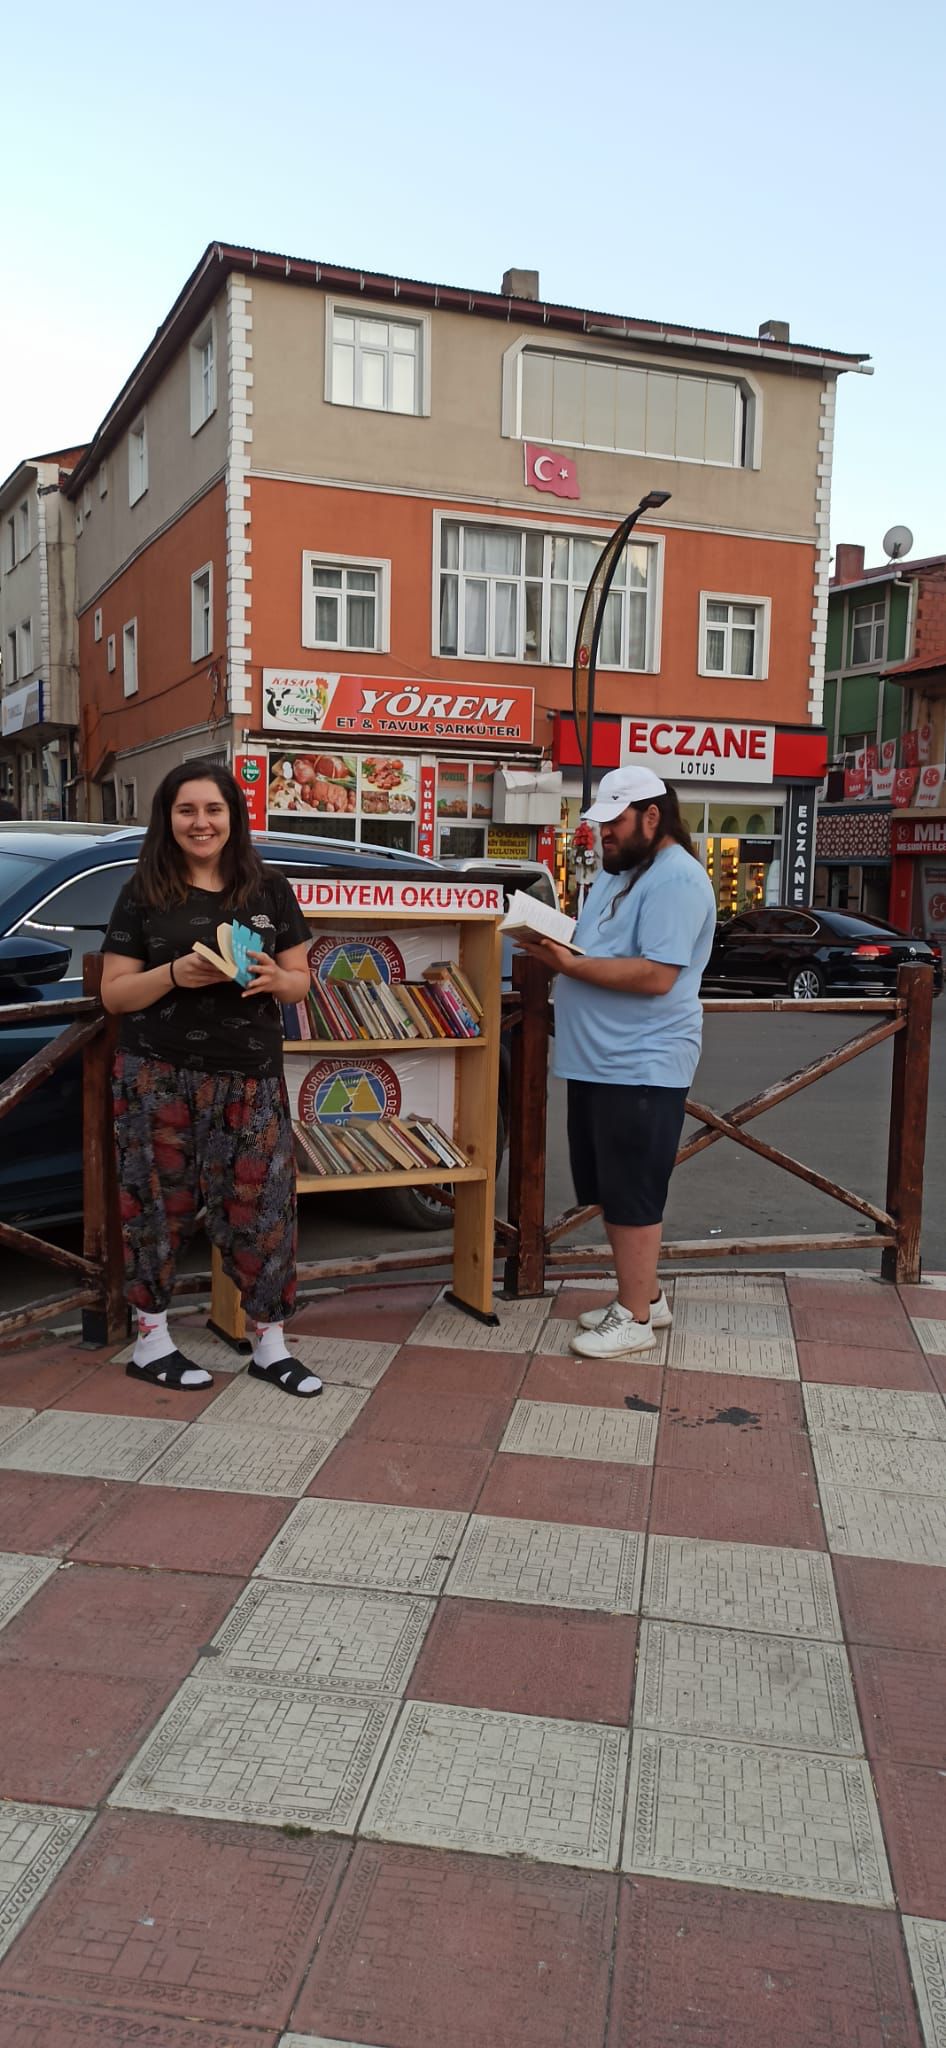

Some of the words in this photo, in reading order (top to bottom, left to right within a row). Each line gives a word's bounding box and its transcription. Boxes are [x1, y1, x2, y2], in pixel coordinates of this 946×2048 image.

[272, 677, 314, 687] KASAP
[359, 686, 516, 721] YÖREM
[336, 717, 356, 728] ET
[362, 719, 373, 729] &
[379, 720, 429, 732] TAVUK
[435, 722, 520, 737] ŞARKÜTERİ
[629, 722, 767, 760] ECZANE
[681, 761, 715, 775] LOTUS
[422, 780, 432, 831] YÖREM
[794, 805, 808, 901] ECZANE
[293, 881, 393, 905] UDİYEM
[400, 887, 499, 909] OKUYOR
[306, 1065, 330, 1091] ORDU
